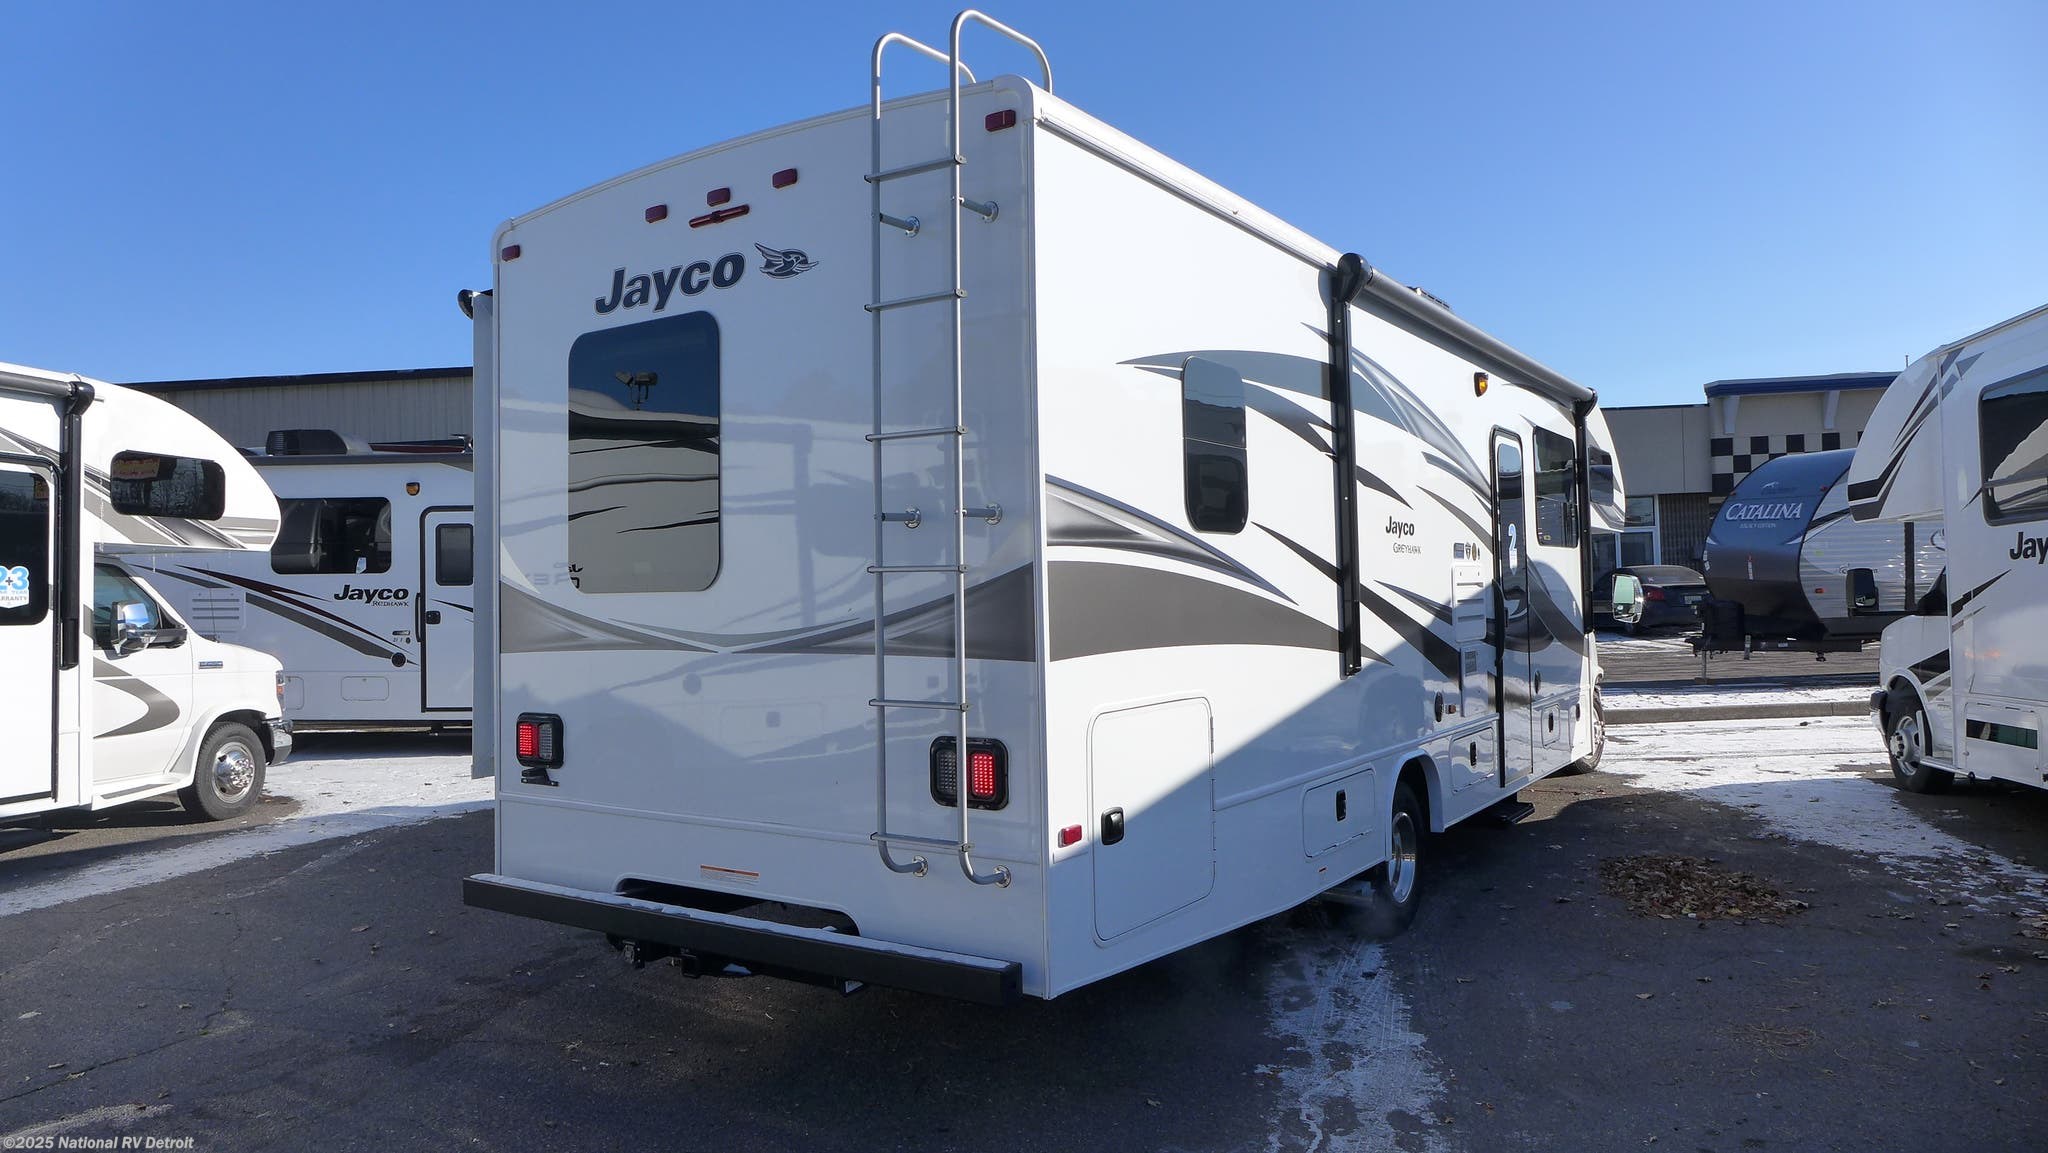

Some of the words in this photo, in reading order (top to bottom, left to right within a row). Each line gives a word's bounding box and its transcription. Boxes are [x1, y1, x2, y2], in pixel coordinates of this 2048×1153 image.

[594, 252, 746, 315] Jayco
[1725, 502, 1804, 521] CATALINA
[1385, 515, 1415, 539] Jayco
[333, 584, 410, 604] Jayco
